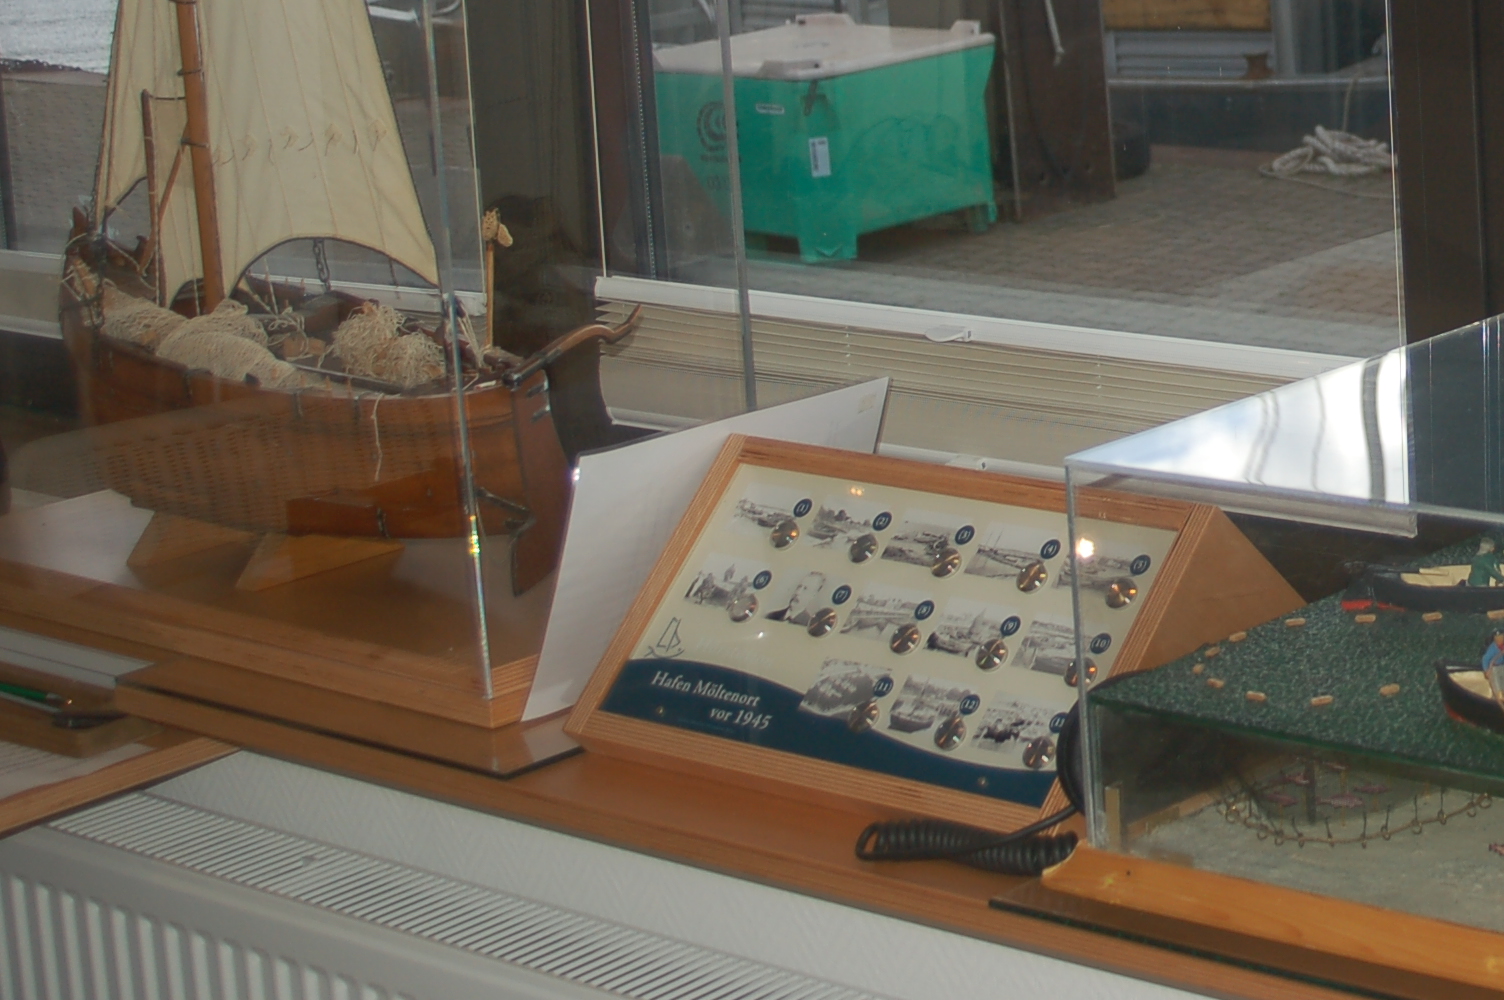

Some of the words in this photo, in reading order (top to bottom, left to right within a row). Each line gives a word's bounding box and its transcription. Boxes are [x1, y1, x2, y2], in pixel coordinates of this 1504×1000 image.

[651, 670, 692, 692] Hafen
[693, 680, 761, 707] Möltenort
[710, 708, 733, 722] vor
[734, 709, 773, 730] 1945
